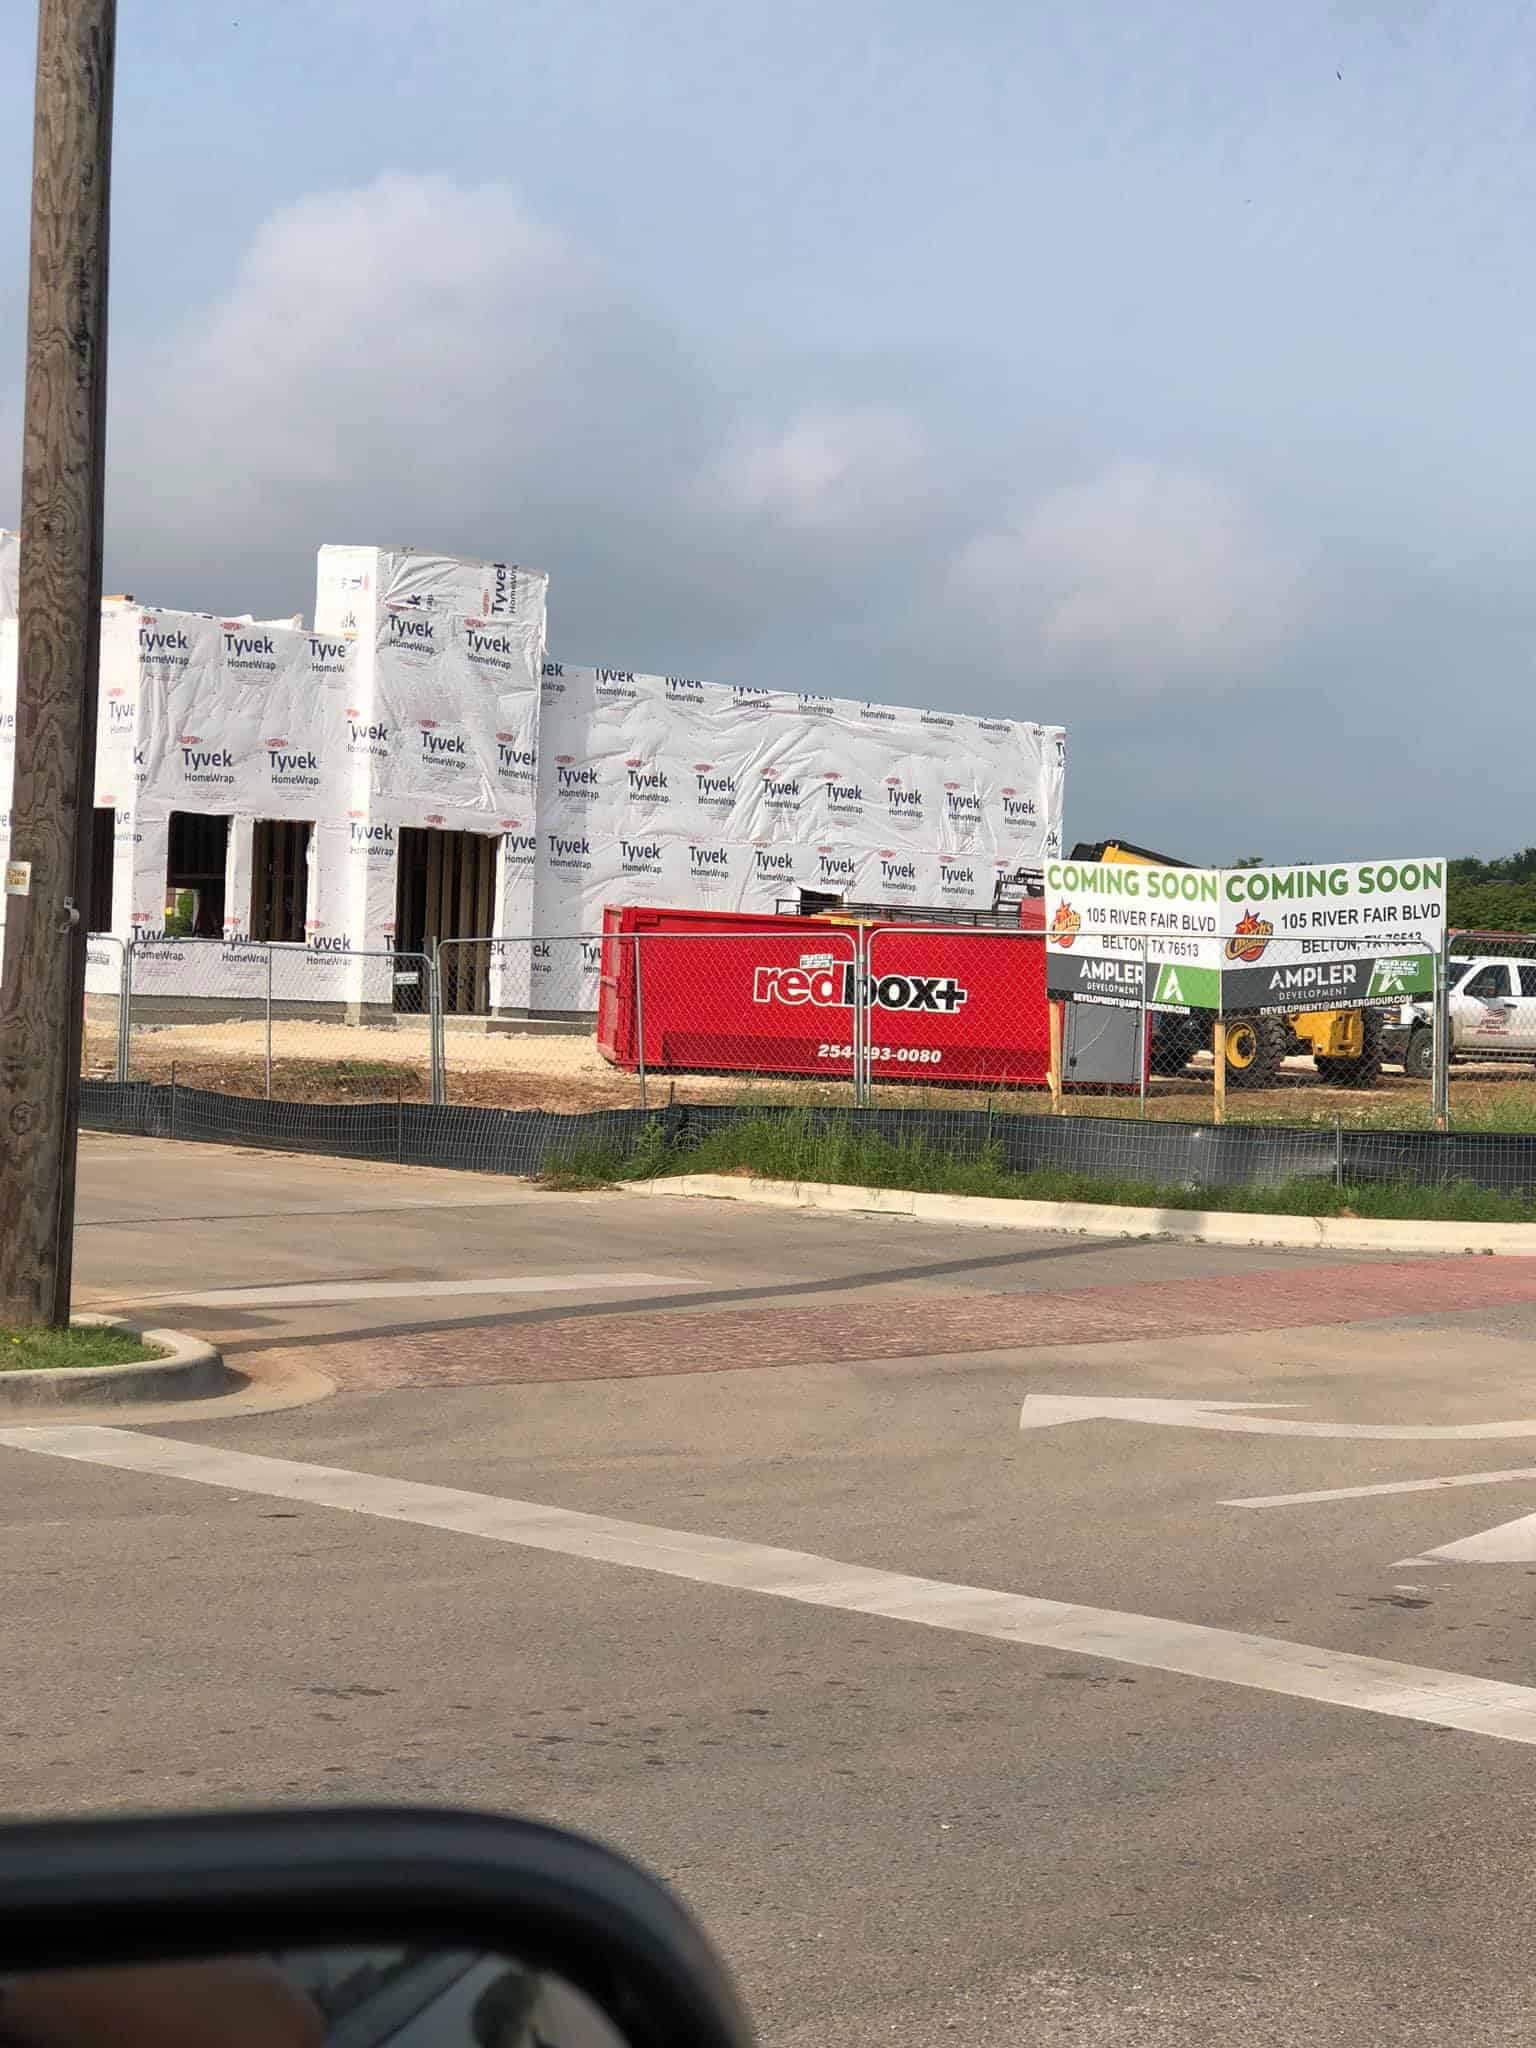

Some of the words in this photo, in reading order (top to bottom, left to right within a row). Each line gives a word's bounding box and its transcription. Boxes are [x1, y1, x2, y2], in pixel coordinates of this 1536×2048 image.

[389, 614, 434, 638] Tyvek
[139, 628, 188, 652] Tyvek
[224, 634, 274, 656] Tyvek
[389, 638, 435, 655] HomeWrap
[466, 630, 511, 654] Tyvek
[308, 639, 346, 661] Tyve
[227, 658, 276, 671] HomeWrap
[311, 662, 345, 673] HomeW
[467, 654, 511, 671] HomeWrap
[595, 686, 636, 698] HomeWrap
[108, 701, 135, 721] Tyve
[421, 730, 465, 754] Tyvek
[181, 748, 233, 771] Tyvek
[268, 751, 317, 773] Tyvek
[422, 754, 466, 770] HomeWrap
[184, 772, 234, 784] HomeWrap
[271, 773, 319, 785] HomeWrap
[498, 767, 537, 784] HomeWra
[557, 766, 598, 786] Tyvek
[627, 770, 668, 790] Tyvek
[696, 774, 735, 794] Tyvek
[558, 788, 599, 800] HomeWrap
[762, 778, 799, 797] Tyvek
[826, 783, 862, 802] Tyvek
[629, 792, 669, 804] HomeWrap
[698, 796, 736, 808] HomeWrap
[764, 799, 800, 811] HomeWrap
[887, 787, 922, 807] Tyvek
[946, 792, 980, 810] Tyvek
[1003, 797, 1036, 815] Tyvek
[827, 803, 863, 815] HomeWrap
[889, 808, 924, 819] HomeWrap
[949, 811, 982, 823] HomeWrap
[1004, 816, 1037, 828] HomeWrap
[350, 823, 393, 843] Tyvek
[503, 832, 537, 853] Tyve
[548, 836, 590, 856] Tyvek
[620, 841, 660, 859] Tyvek
[505, 855, 536, 865] HomeW
[549, 857, 592, 870] HomeWrap
[689, 846, 728, 866] Tyvek
[755, 851, 793, 870] Tyvek
[819, 856, 855, 874] Tyvek
[622, 862, 662, 874] HomeWrap
[691, 867, 729, 879] HomeWrap
[881, 860, 915, 879] Tyvek
[940, 865, 974, 884] Tyvek
[757, 872, 794, 883] HomeWrap
[820, 876, 856, 888] HomeWrap
[882, 881, 916, 892] HomeWrap
[1047, 864, 1139, 897] COMING
[1147, 871, 1218, 903] SOON
[1225, 868, 1350, 903] COMING
[1358, 863, 1442, 894] SOON
[941, 884, 975, 896] HomeWrap
[1087, 907, 1106, 924] 105
[1110, 909, 1147, 927] RIVER
[1151, 912, 1180, 929] FAIR
[1182, 915, 1216, 932] BLVD
[1281, 912, 1308, 929] 105
[1312, 909, 1358, 928] RIVER
[1363, 906, 1398, 923] FAIR
[1402, 903, 1441, 921] BLVD
[131, 925, 166, 947] Tyv
[133, 950, 185, 961] HomeWrap
[580, 942, 602, 962] Tyv
[1152, 940, 1166, 954] TX
[1168, 941, 1200, 957] 76513
[531, 962, 552, 973] Wrap
[1079, 959, 1144, 984] AMPLER
[1268, 964, 1357, 990] AMPLER
[1087, 982, 1139, 995] DEVELOPMENT
[1279, 987, 1349, 1001] DEVELOPMENT
